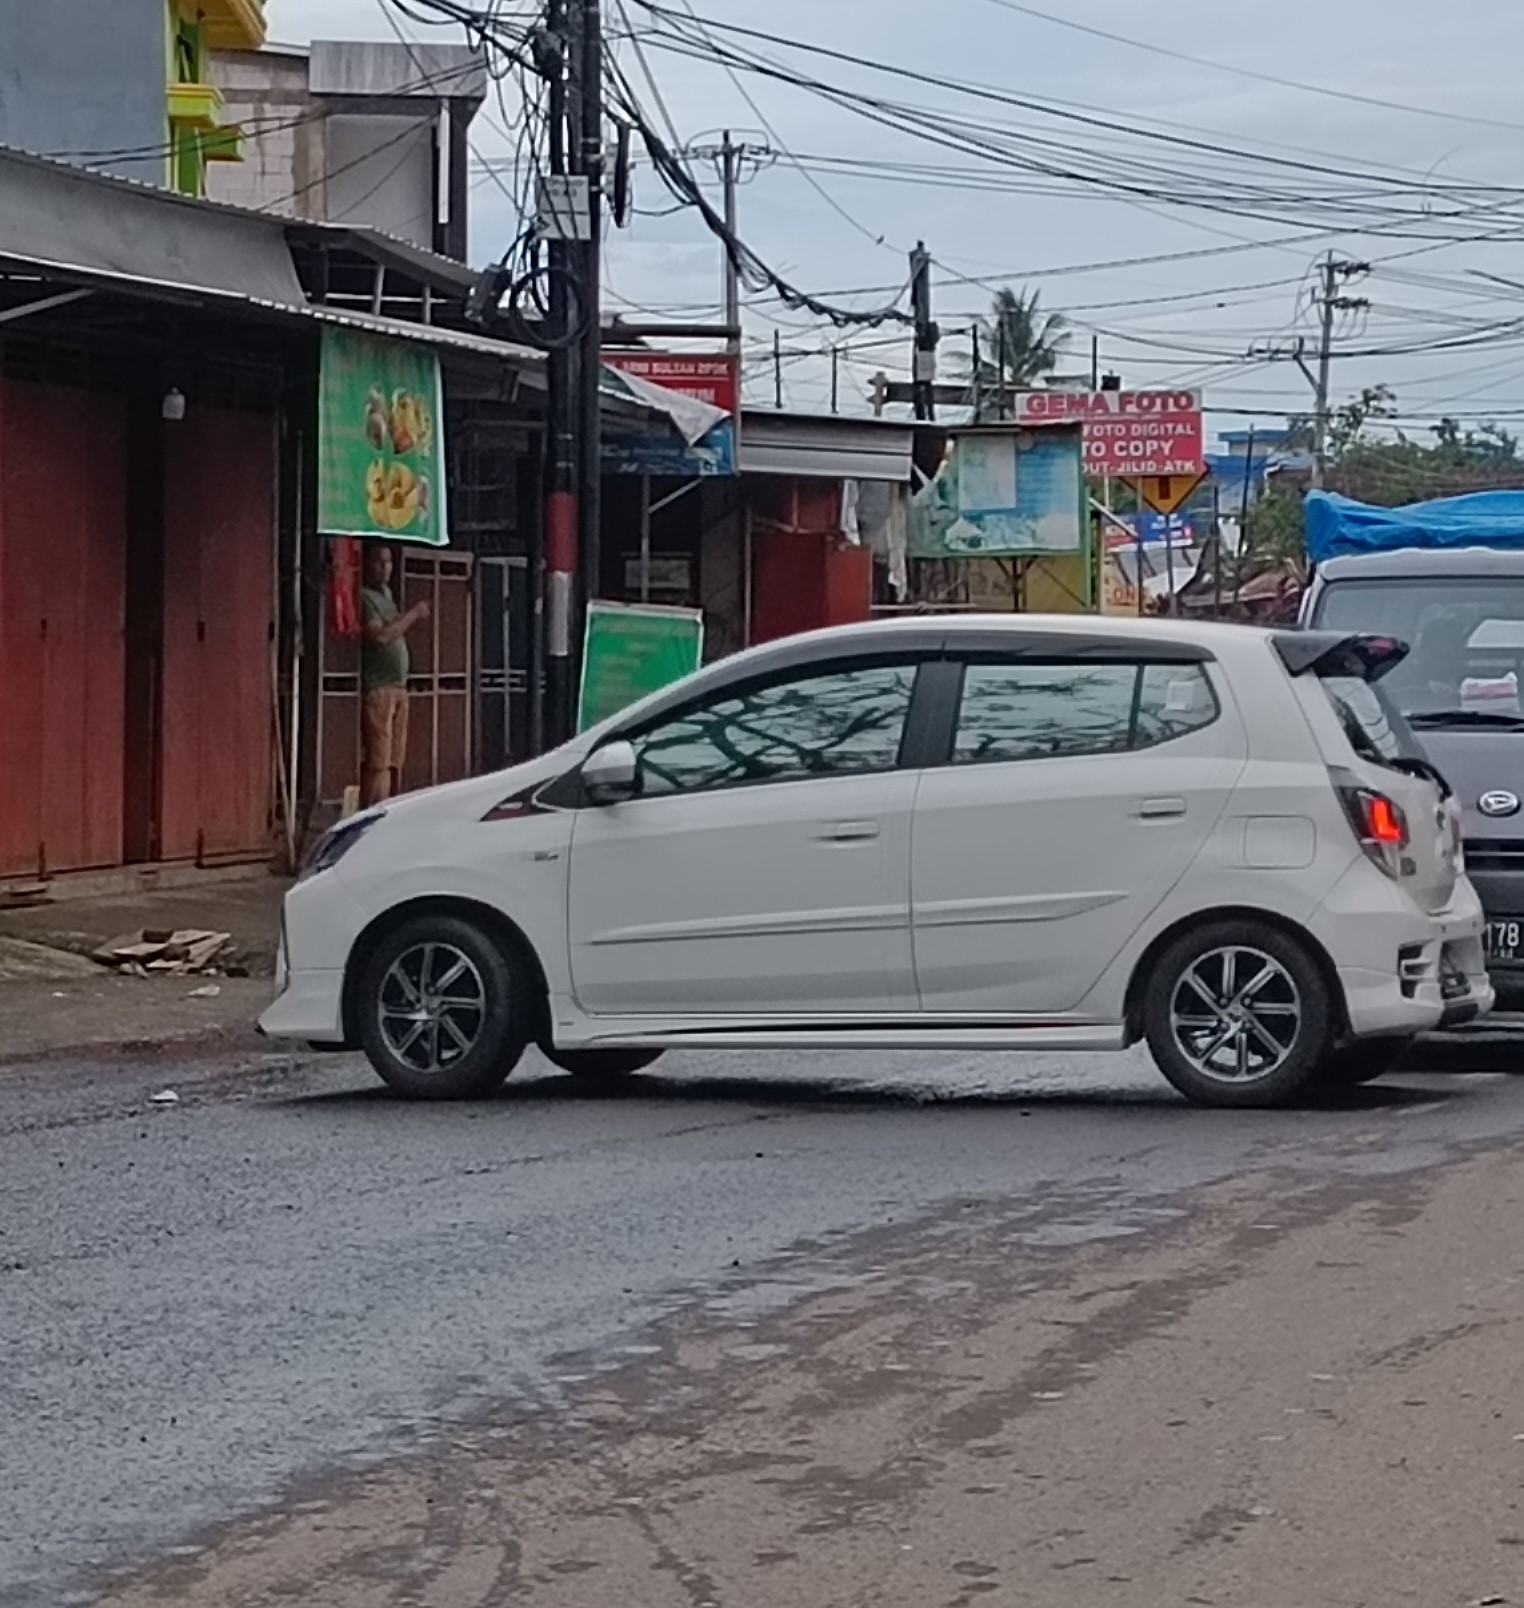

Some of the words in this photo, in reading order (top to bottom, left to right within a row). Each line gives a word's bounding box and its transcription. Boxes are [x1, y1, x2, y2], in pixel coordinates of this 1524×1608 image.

[1026, 393, 1110, 414] GEMA
[1118, 390, 1194, 412] FOTO
[1130, 422, 1195, 436] DIGITAL
[1114, 439, 1174, 457] COPY
